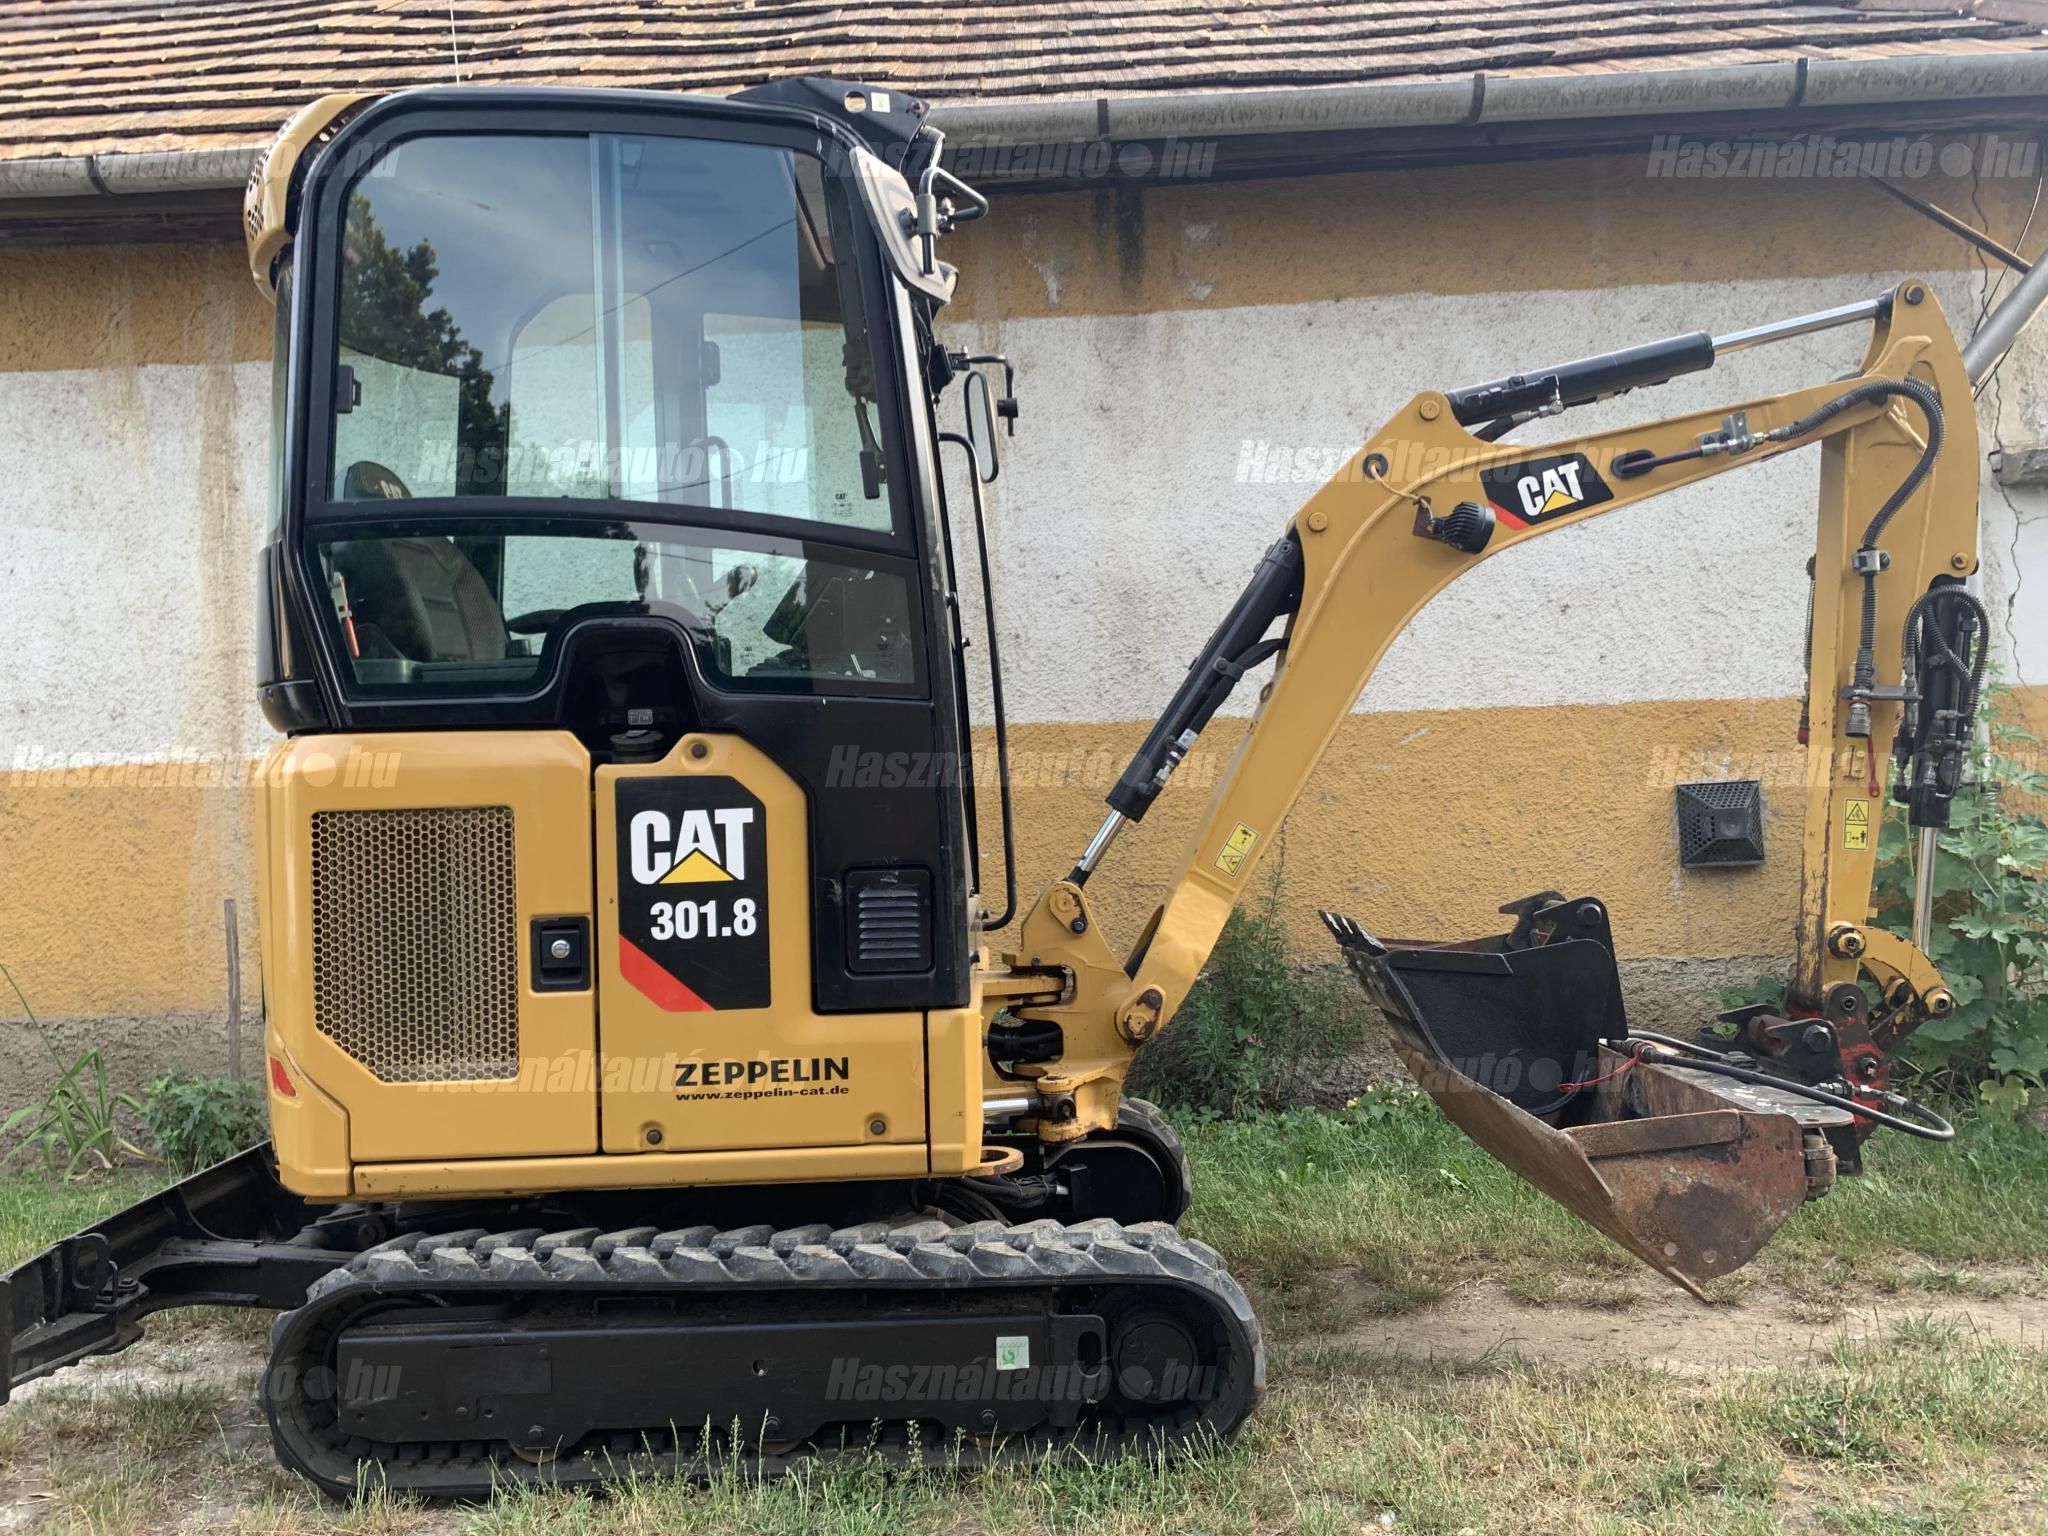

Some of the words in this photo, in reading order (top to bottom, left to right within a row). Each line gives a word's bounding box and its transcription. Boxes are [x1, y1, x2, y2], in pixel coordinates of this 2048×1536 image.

[1517, 461, 1584, 517] CAT
[630, 808, 754, 885] CAT
[650, 898, 757, 940] 301.8
[675, 1057, 849, 1087] ZEPPELIN
[675, 1085, 849, 1101] www.zeppelin-cat.de
